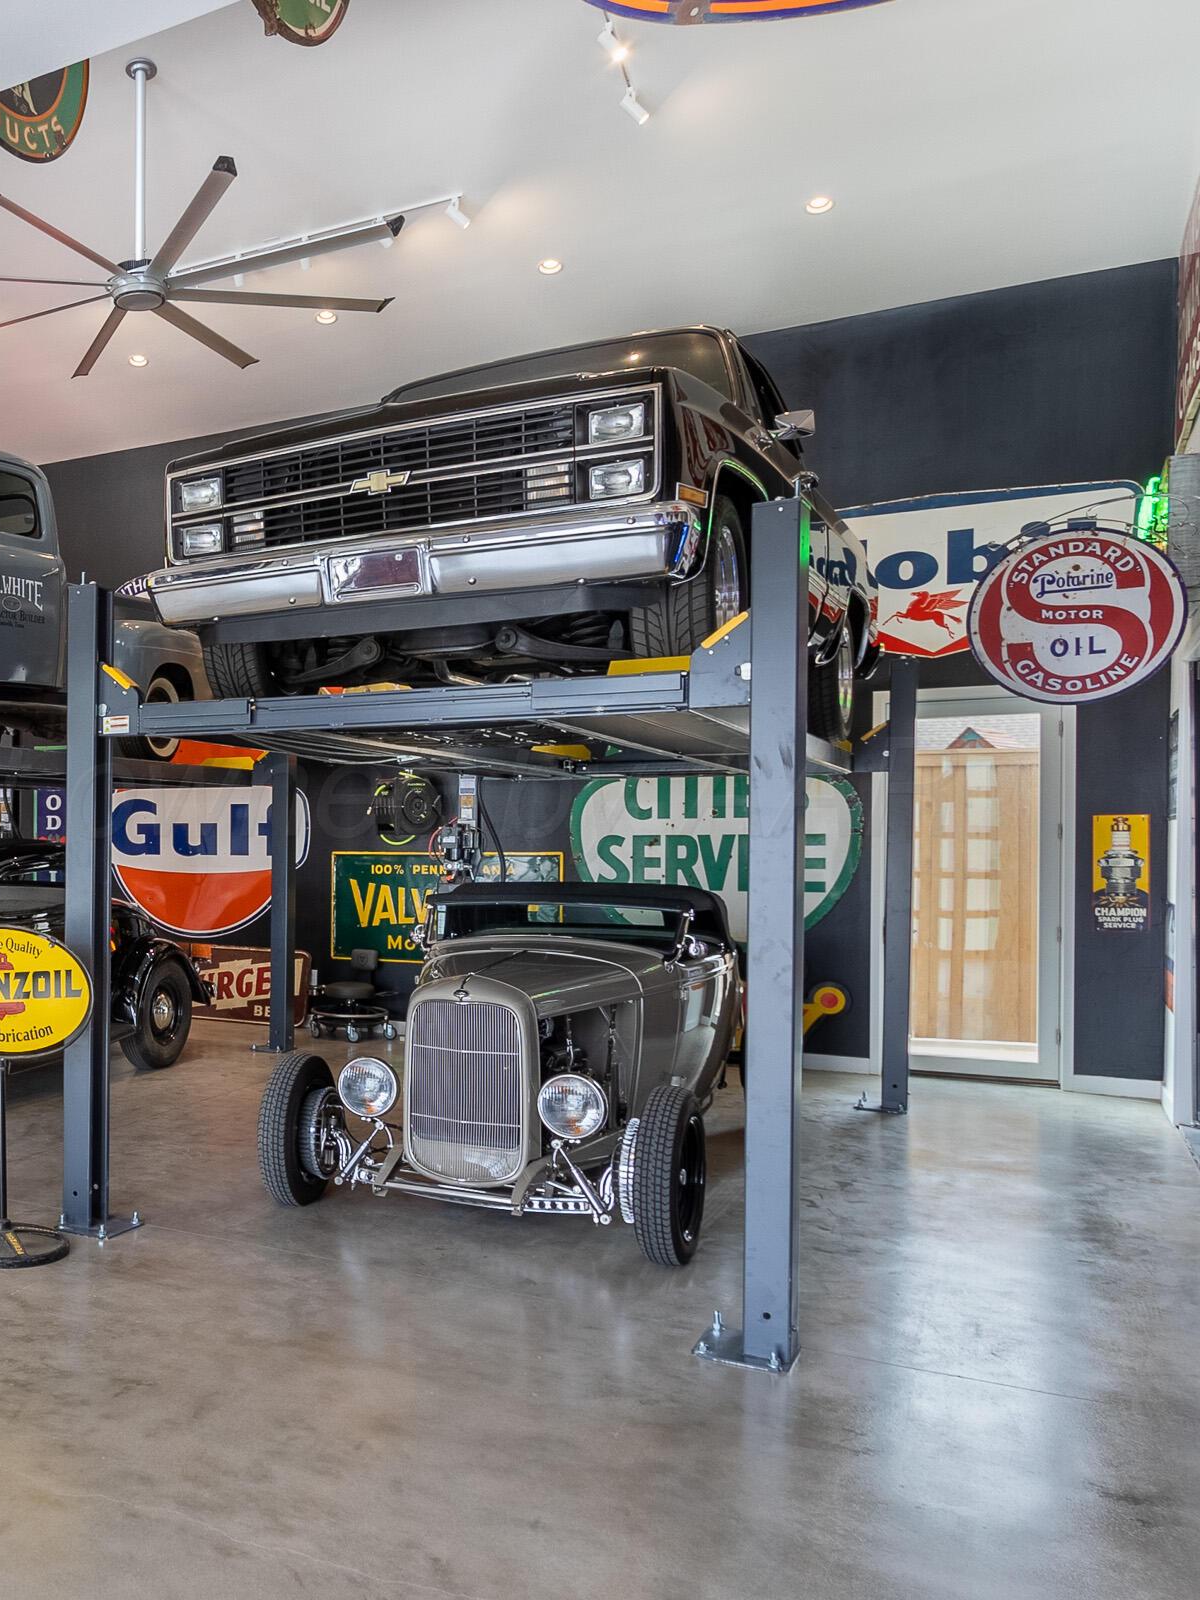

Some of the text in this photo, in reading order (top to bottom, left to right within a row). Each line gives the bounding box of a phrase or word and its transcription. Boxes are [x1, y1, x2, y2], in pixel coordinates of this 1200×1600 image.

[1041, 608, 1104, 620] MOTOR
[1050, 635, 1107, 658] OIL
[1016, 652, 1140, 692] GASOLINE
[371, 864, 404, 875] 100%
[597, 834, 827, 893] SERVIE
[1094, 907, 1147, 917] CHAMPION
[5, 937, 43, 959] Quality
